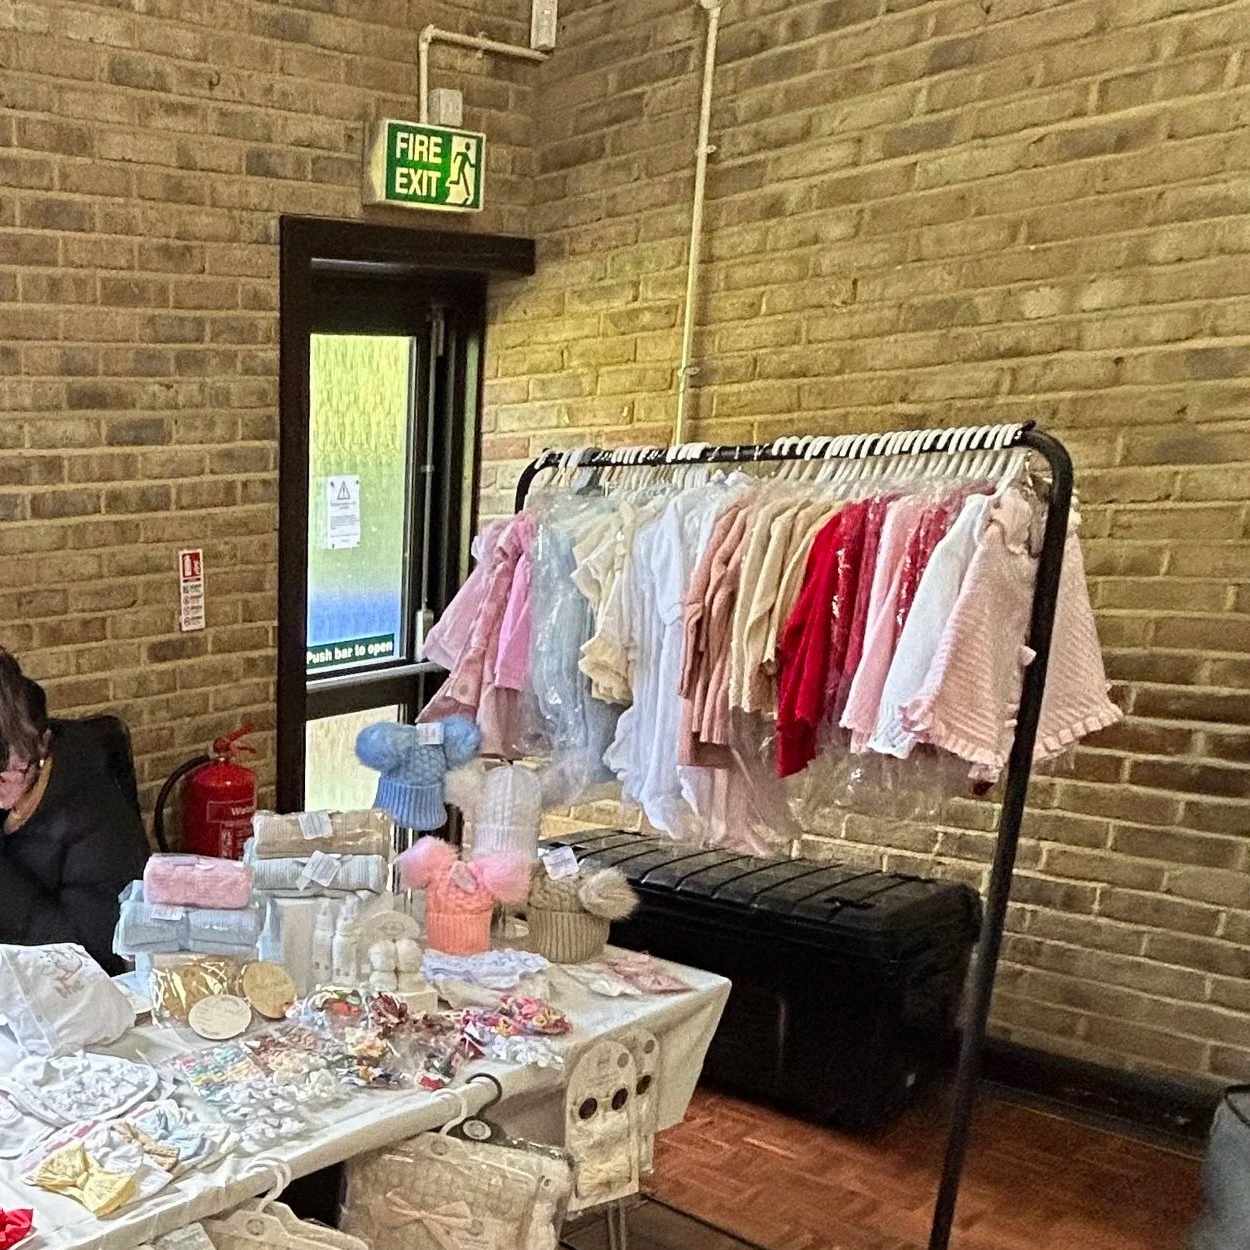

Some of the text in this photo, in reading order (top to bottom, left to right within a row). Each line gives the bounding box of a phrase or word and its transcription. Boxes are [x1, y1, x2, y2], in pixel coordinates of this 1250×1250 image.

[396, 132, 442, 164] FIRE
[395, 166, 441, 197] EXIT
[306, 640, 393, 664] Push bar to open
